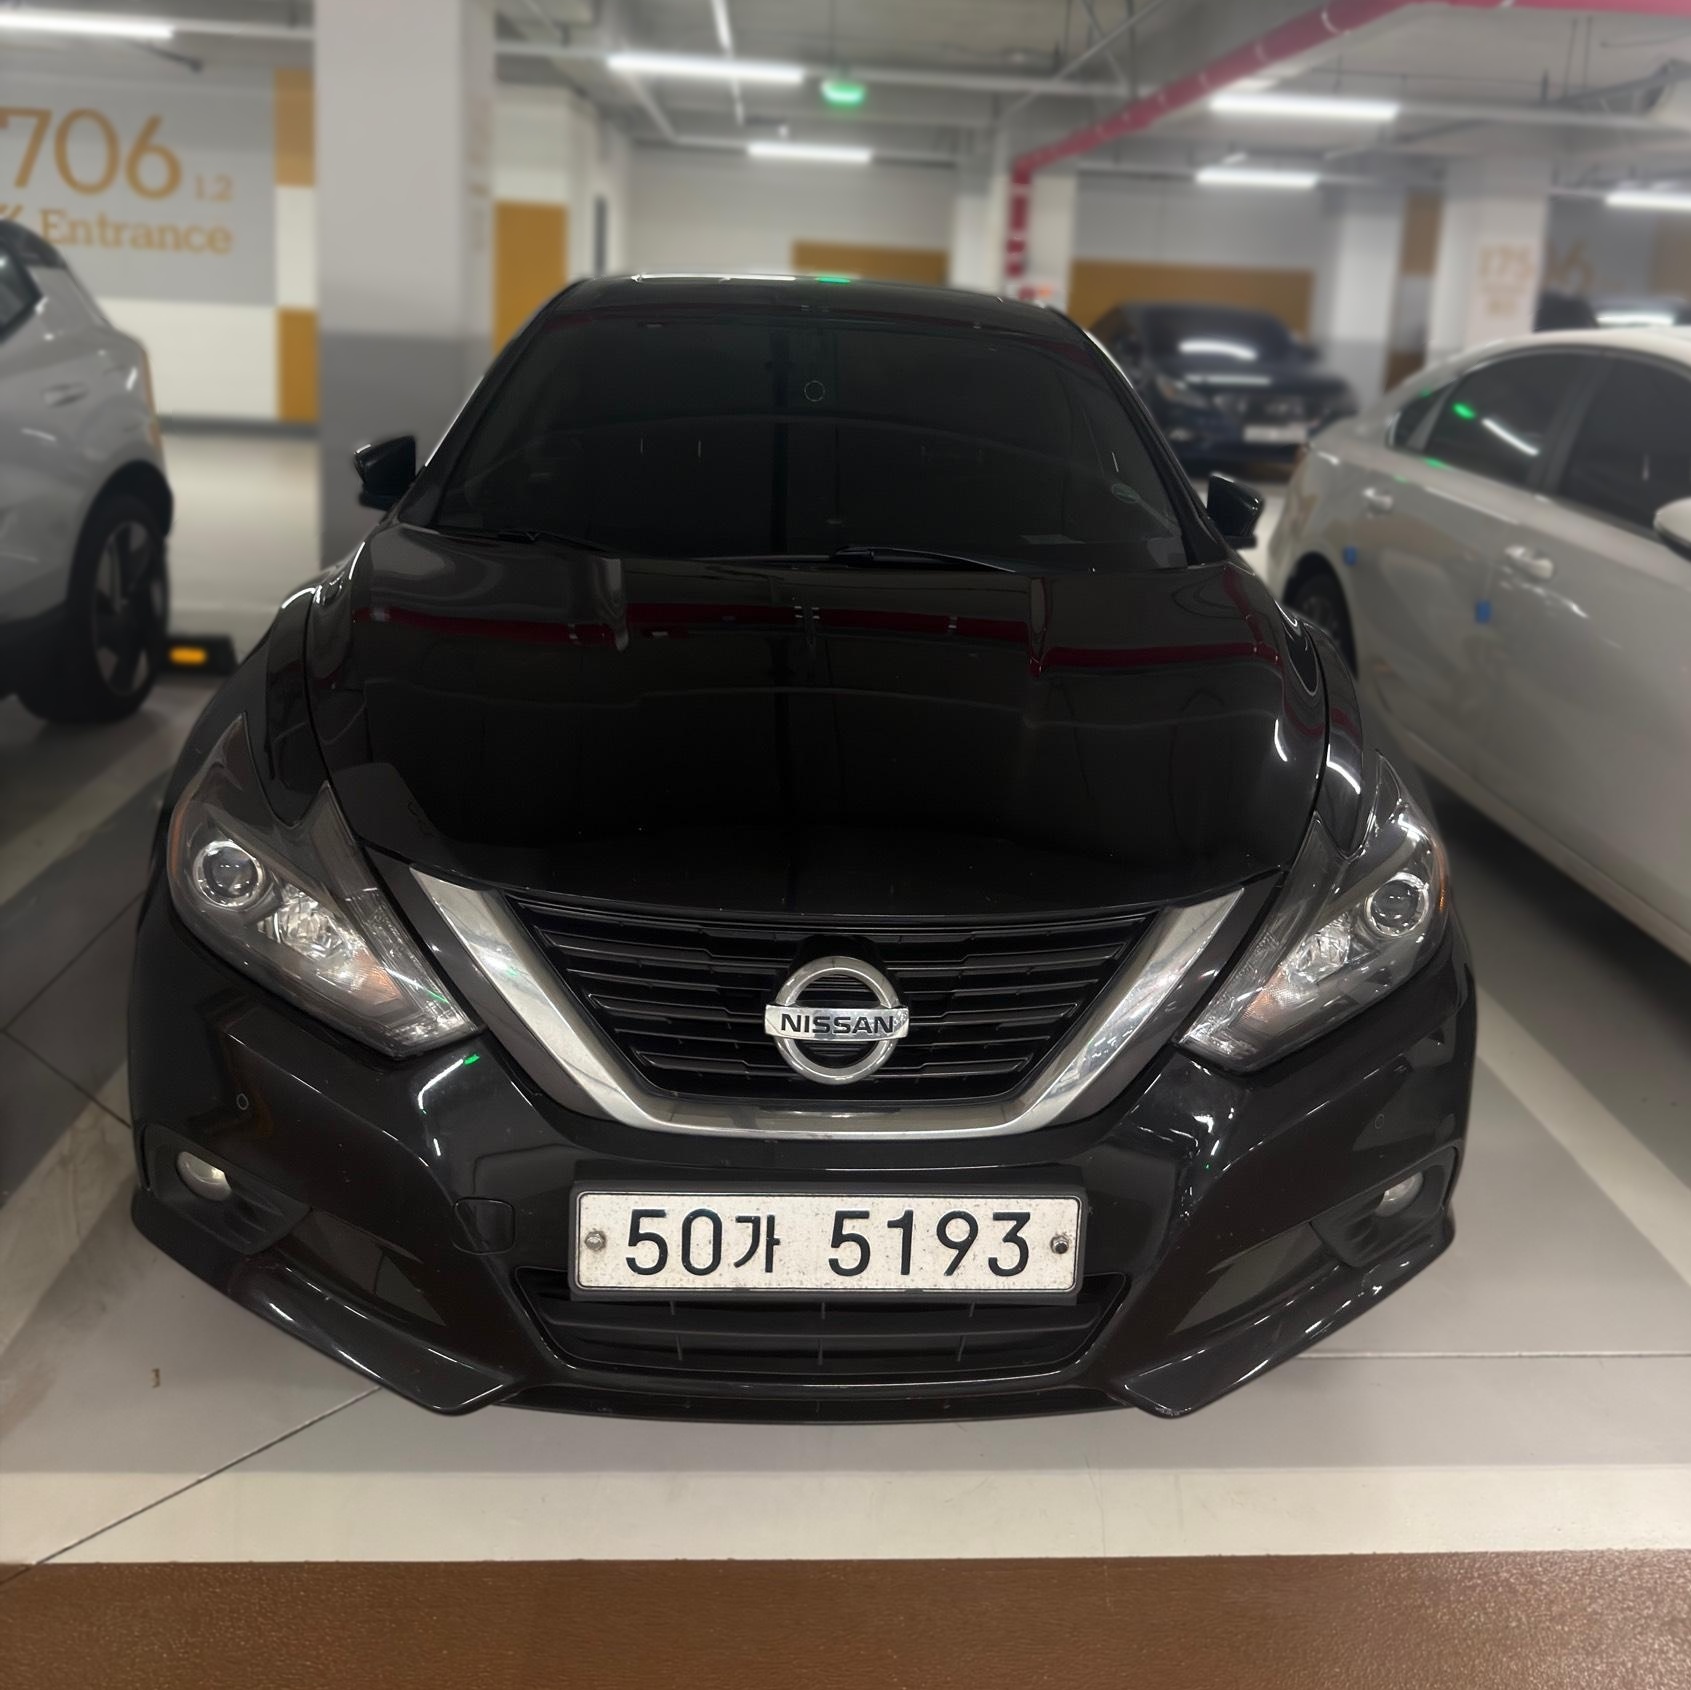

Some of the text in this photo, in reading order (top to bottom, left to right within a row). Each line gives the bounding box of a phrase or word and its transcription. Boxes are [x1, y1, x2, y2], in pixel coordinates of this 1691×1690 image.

[40, 208, 234, 255] Entrance
[780, 1013, 894, 1034] NISSAN
[626, 1208, 1031, 1277] 50가 5193
